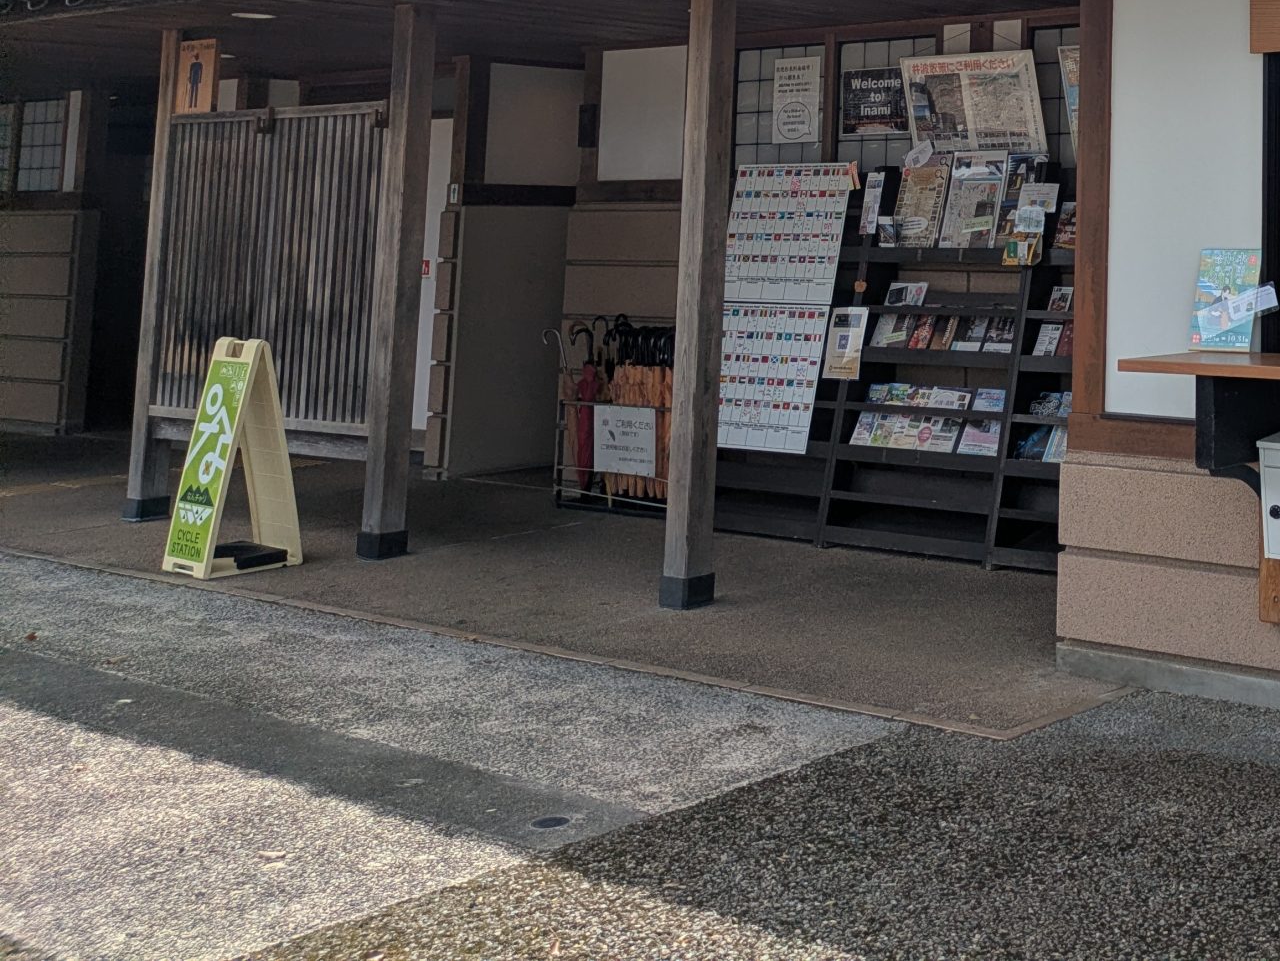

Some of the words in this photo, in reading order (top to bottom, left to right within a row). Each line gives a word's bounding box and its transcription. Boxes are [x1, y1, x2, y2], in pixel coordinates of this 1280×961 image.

[911, 57, 1016, 75] 井波散策にご利用ください
[851, 76, 901, 89] Welcome
[869, 91, 884, 103] to
[860, 103, 891, 117] Inami
[177, 529, 200, 544] CYCLE
[171, 541, 202, 558] STATION
